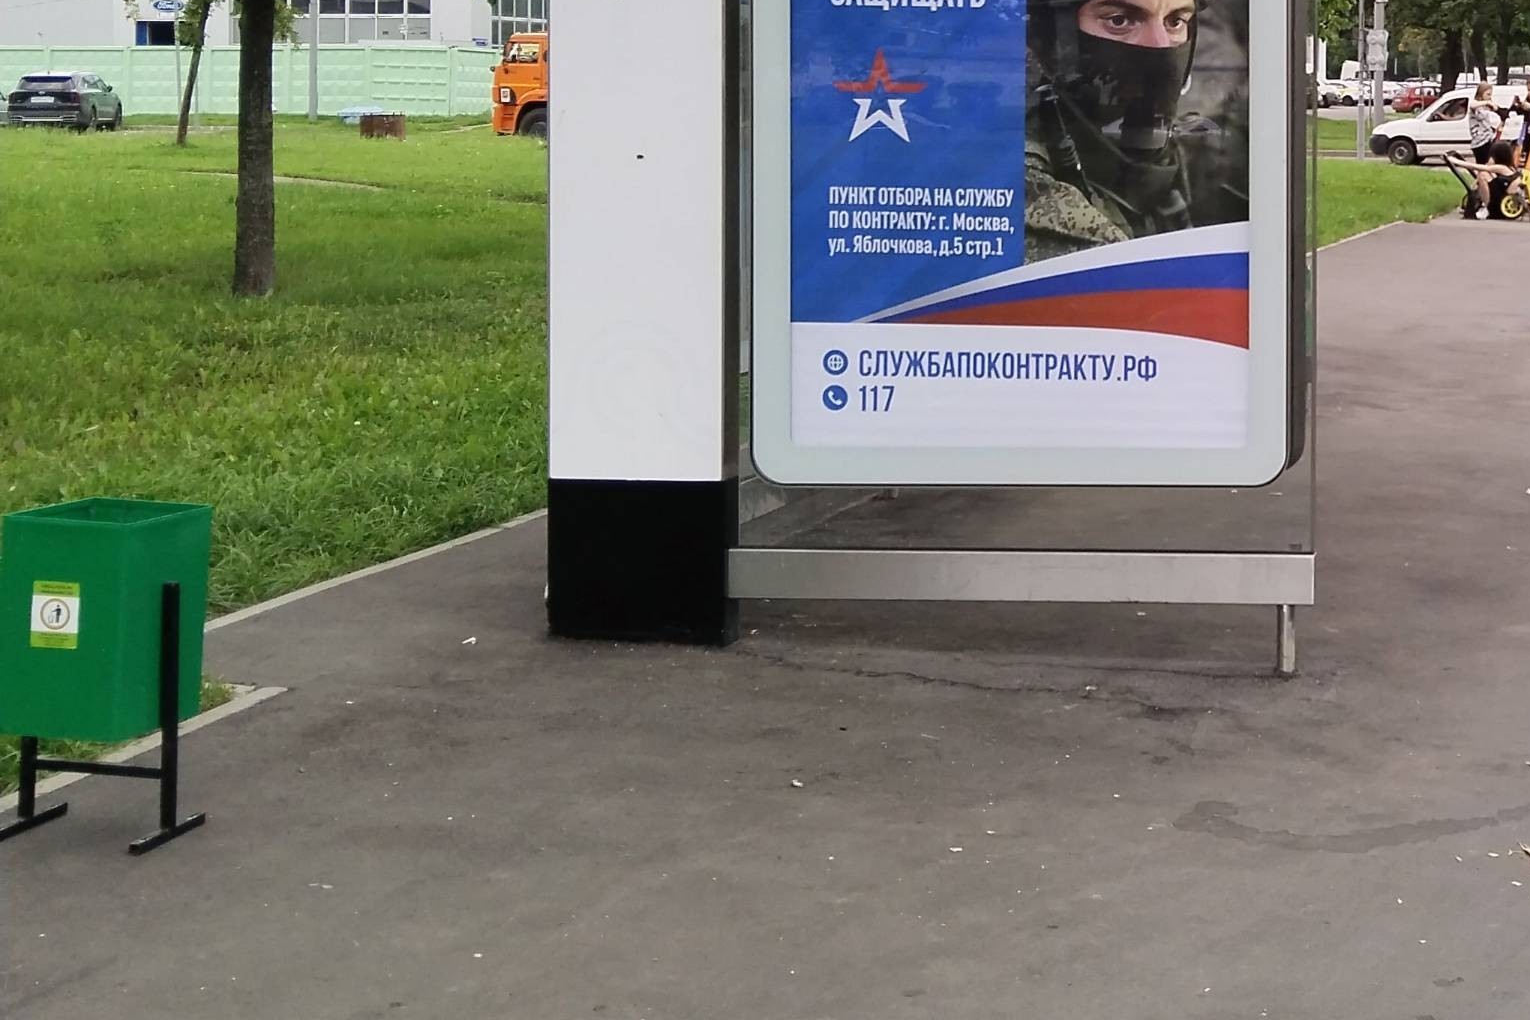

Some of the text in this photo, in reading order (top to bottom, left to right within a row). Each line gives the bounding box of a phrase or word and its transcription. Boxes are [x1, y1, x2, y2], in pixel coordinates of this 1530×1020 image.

[829, 186, 1014, 207] ПУНКТ ОТБОРА НА СЛУЖБУ
[829, 211, 1014, 233] ПО КОНТРАКТУ: г. Москва,
[828, 236, 1003, 259] ул. Яблочкова, д.5 стр.1
[858, 350, 1158, 382] СЛУЖБАПОКОНТРАКТУ.РФ
[859, 385, 895, 412] 117
